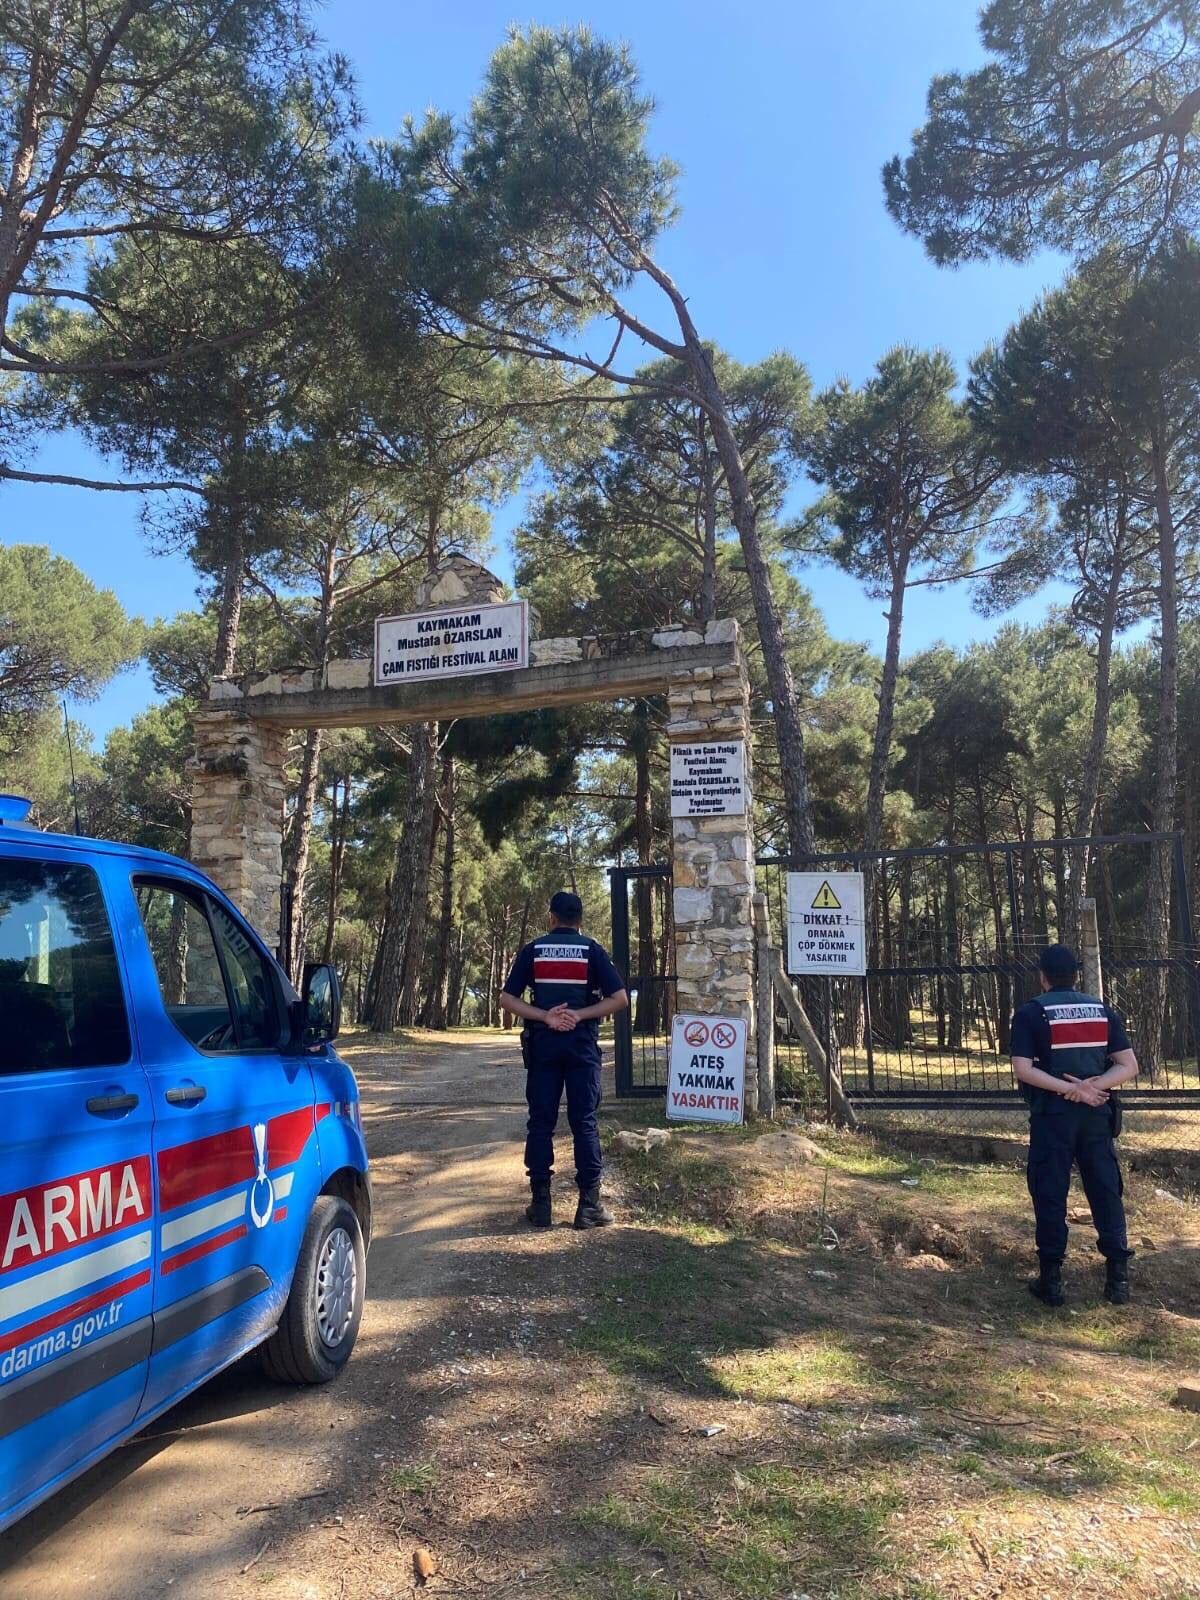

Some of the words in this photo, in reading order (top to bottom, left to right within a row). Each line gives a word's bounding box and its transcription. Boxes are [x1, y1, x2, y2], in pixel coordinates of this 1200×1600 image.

[417, 614, 481, 633] KAYMAKAM
[397, 635, 441, 651] Mustafa
[443, 627, 502, 644] ÖZARSLAN
[382, 659, 405, 677] ÇAM
[442, 650, 486, 668] FESTİVAL
[488, 647, 518, 662] ALANI
[672, 747, 692, 755] Piknik
[688, 767, 722, 776] Kaymakam
[803, 912, 842, 925] DİKKAT
[807, 929, 845, 938] ORMANA
[539, 947, 583, 958] JANDARMA
[798, 939, 816, 951] ÇÖP
[818, 939, 855, 951] DÖKMEK
[806, 953, 847, 962] YASAKTIR
[1053, 1007, 1102, 1019] JANDARMA
[690, 1054, 725, 1073] ATEŞ
[678, 1072, 735, 1091] YAKMAK
[671, 1092, 739, 1111] YASAKTIR
[1, 1164, 145, 1268] ARMA
[1, 1300, 123, 1378] darma.gov.tr
